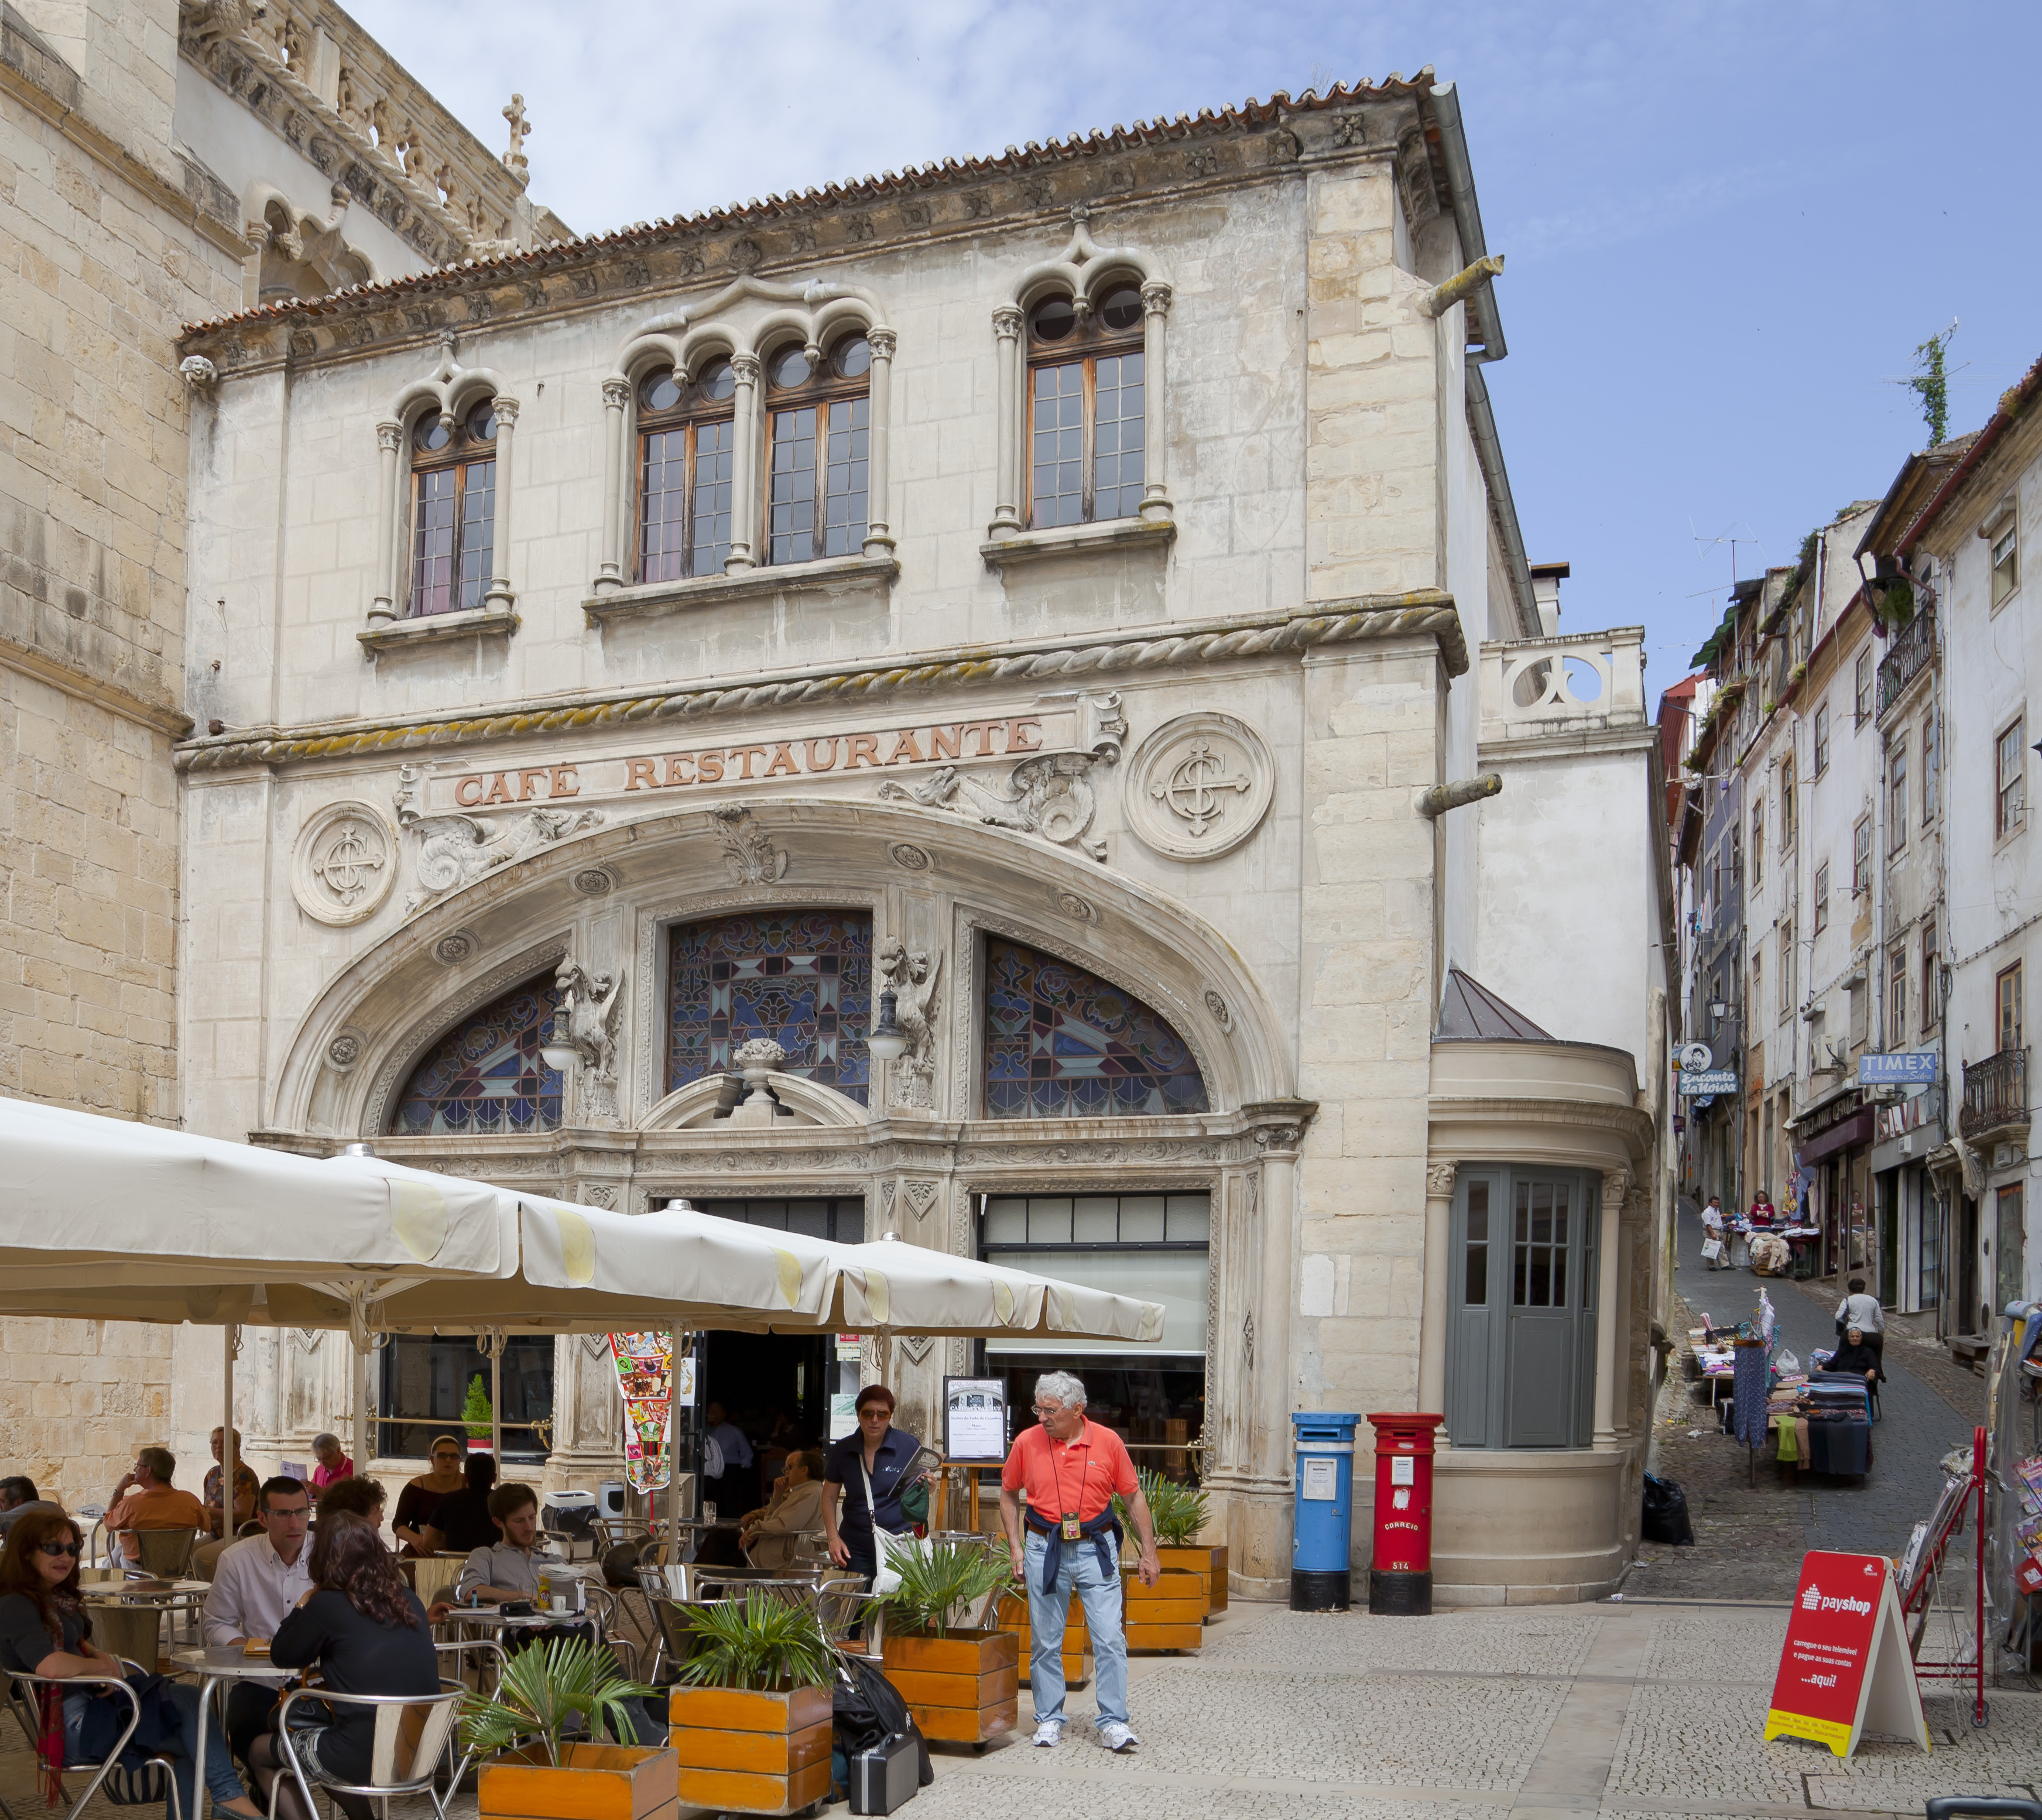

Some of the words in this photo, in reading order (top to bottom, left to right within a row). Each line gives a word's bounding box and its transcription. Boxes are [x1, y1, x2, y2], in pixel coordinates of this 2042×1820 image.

[455, 761, 580, 806] CAFÉ
[625, 716, 1043, 790] RESTAURANTE
[1863, 1055, 1932, 1071] TIMEX
[1681, 1071, 1735, 1084] Encanto
[1909, 1071, 1931, 1080] Silva
[1681, 1083, 1697, 1093] da
[1698, 1082, 1736, 1093] Noiva
[1877, 1096, 1927, 1142] SILVA
[1385, 1521, 1419, 1531] CORREIO
[1393, 1562, 1409, 1570] 514
[1821, 1596, 1870, 1616] payshop
[1793, 1640, 1817, 1649] carregue
[1832, 1646, 1858, 1656] telemóvel
[1797, 1653, 1815, 1661] pague
[1835, 1659, 1852, 1667] contas
[1801, 1674, 1837, 1688] ...aqui!
